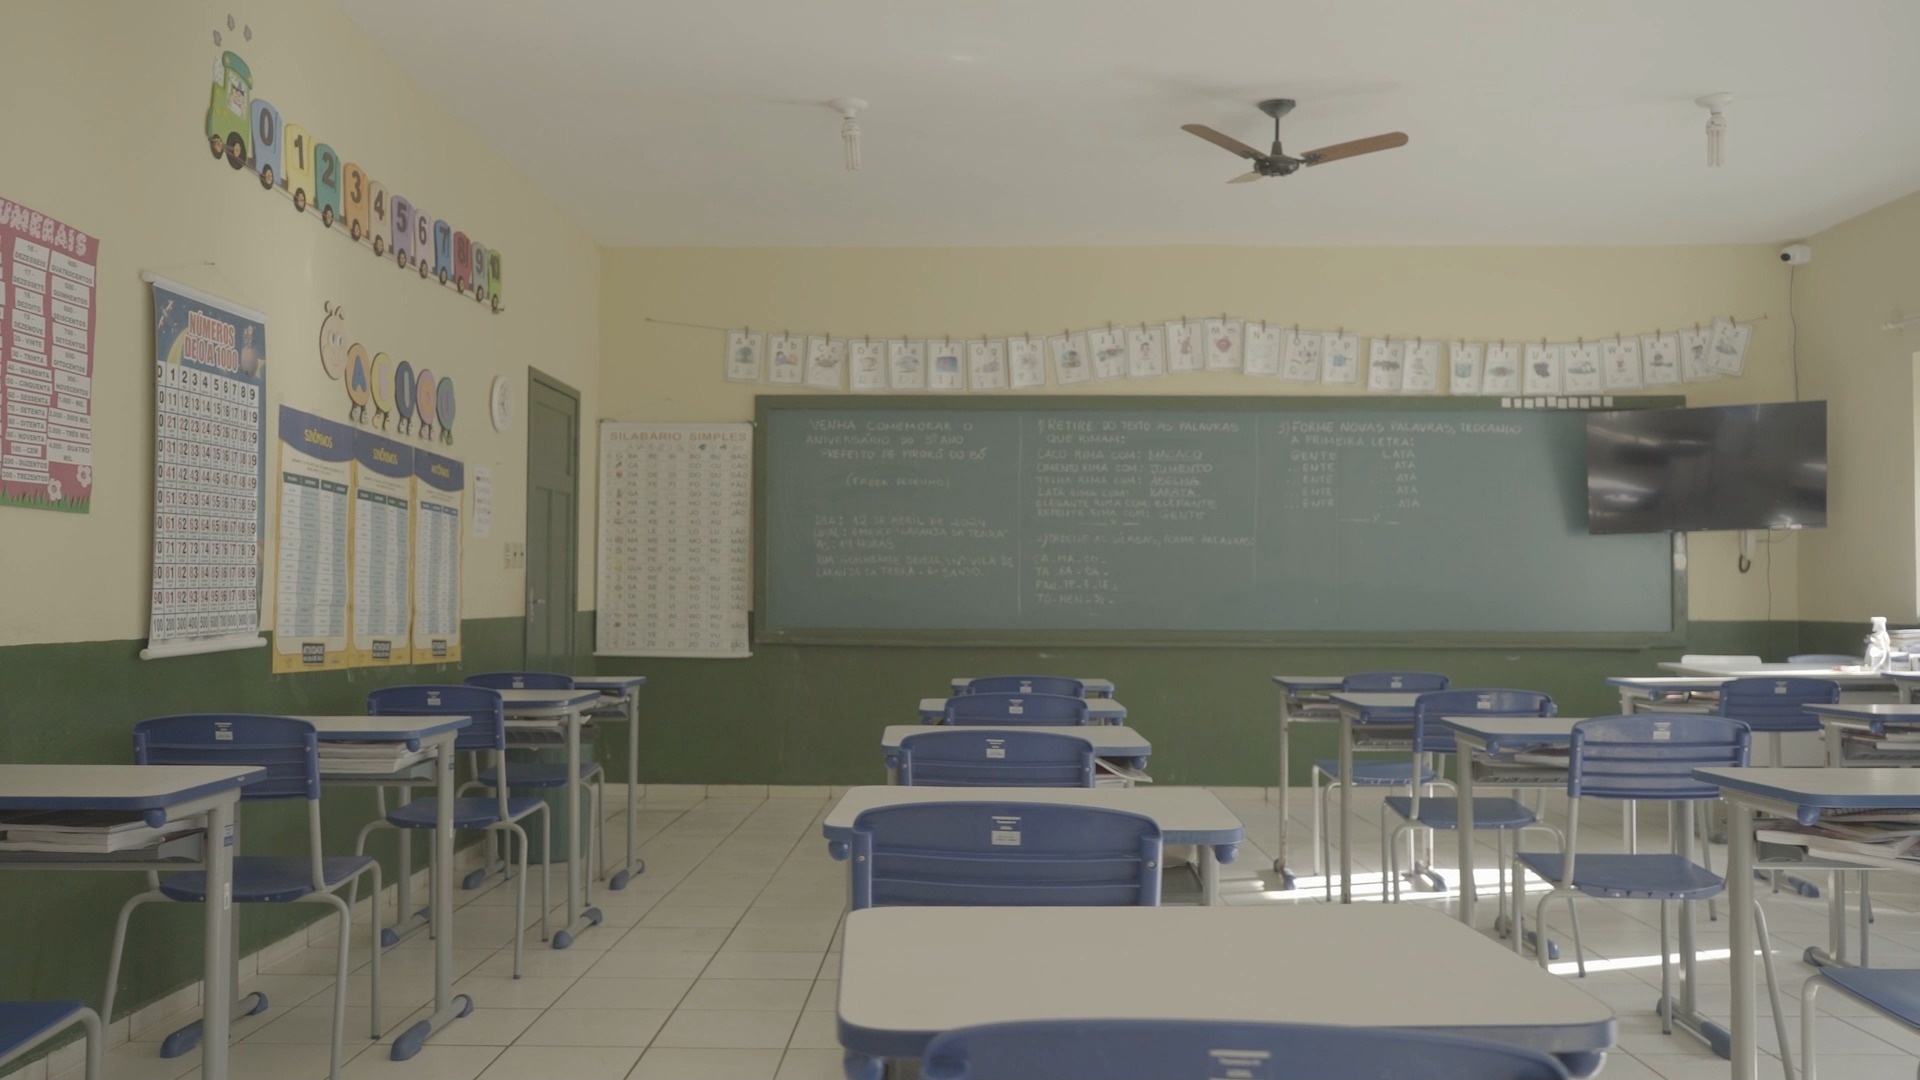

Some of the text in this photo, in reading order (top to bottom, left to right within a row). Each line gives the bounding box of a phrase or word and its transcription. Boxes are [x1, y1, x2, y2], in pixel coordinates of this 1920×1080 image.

[260, 108, 500, 280] 0 1 2 3 4 5 6 7 8 9 10
[0, 200, 87, 256] UMERAIS
[51, 264, 93, 285] QUATROCENTOS
[17, 300, 42, 313] DEZOITO
[188, 311, 236, 348] NÚMEROS
[25, 336, 43, 348] VINTE
[24, 353, 44, 364] TRINTA
[184, 335, 239, 372] DE 0 A 1000
[20, 367, 50, 379] QUARENTA
[19, 380, 51, 392] CINQUENTA
[170, 369, 255, 400] 1 2 3 4 5 6 7 8 9
[352, 355, 367, 393] A
[404, 370, 410, 408] I
[20, 393, 49, 404] SESSENTA
[168, 392, 189, 408] 11 12
[20, 406, 45, 417] SETENTA
[20, 420, 44, 429] OITENTA
[810, 420, 856, 431] VENHA
[866, 422, 952, 431] COMEMORAR
[1179, 421, 1240, 433] PALAVRAS
[1340, 422, 1385, 433] NOVAS
[1460, 422, 1522, 435] TROCANDO
[18, 433, 45, 442] NOVENTA
[689, 432, 747, 442] SIMPLES
[1047, 434, 1073, 444] QUE
[1290, 435, 1299, 444] A
[1306, 435, 1365, 447] PRIMEIRA
[67, 445, 90, 454] QUATRO
[1037, 449, 1067, 459] CACO
[1074, 450, 1105, 460] RIMA
[1290, 449, 1416, 461] GENTE LATA
[1082, 464, 1109, 473] RIMA
[1038, 488, 1065, 497] LATA
[166, 517, 174, 529] 61
[178, 541, 187, 554] 72
[165, 567, 174, 579] 81
[177, 591, 186, 603] 92
